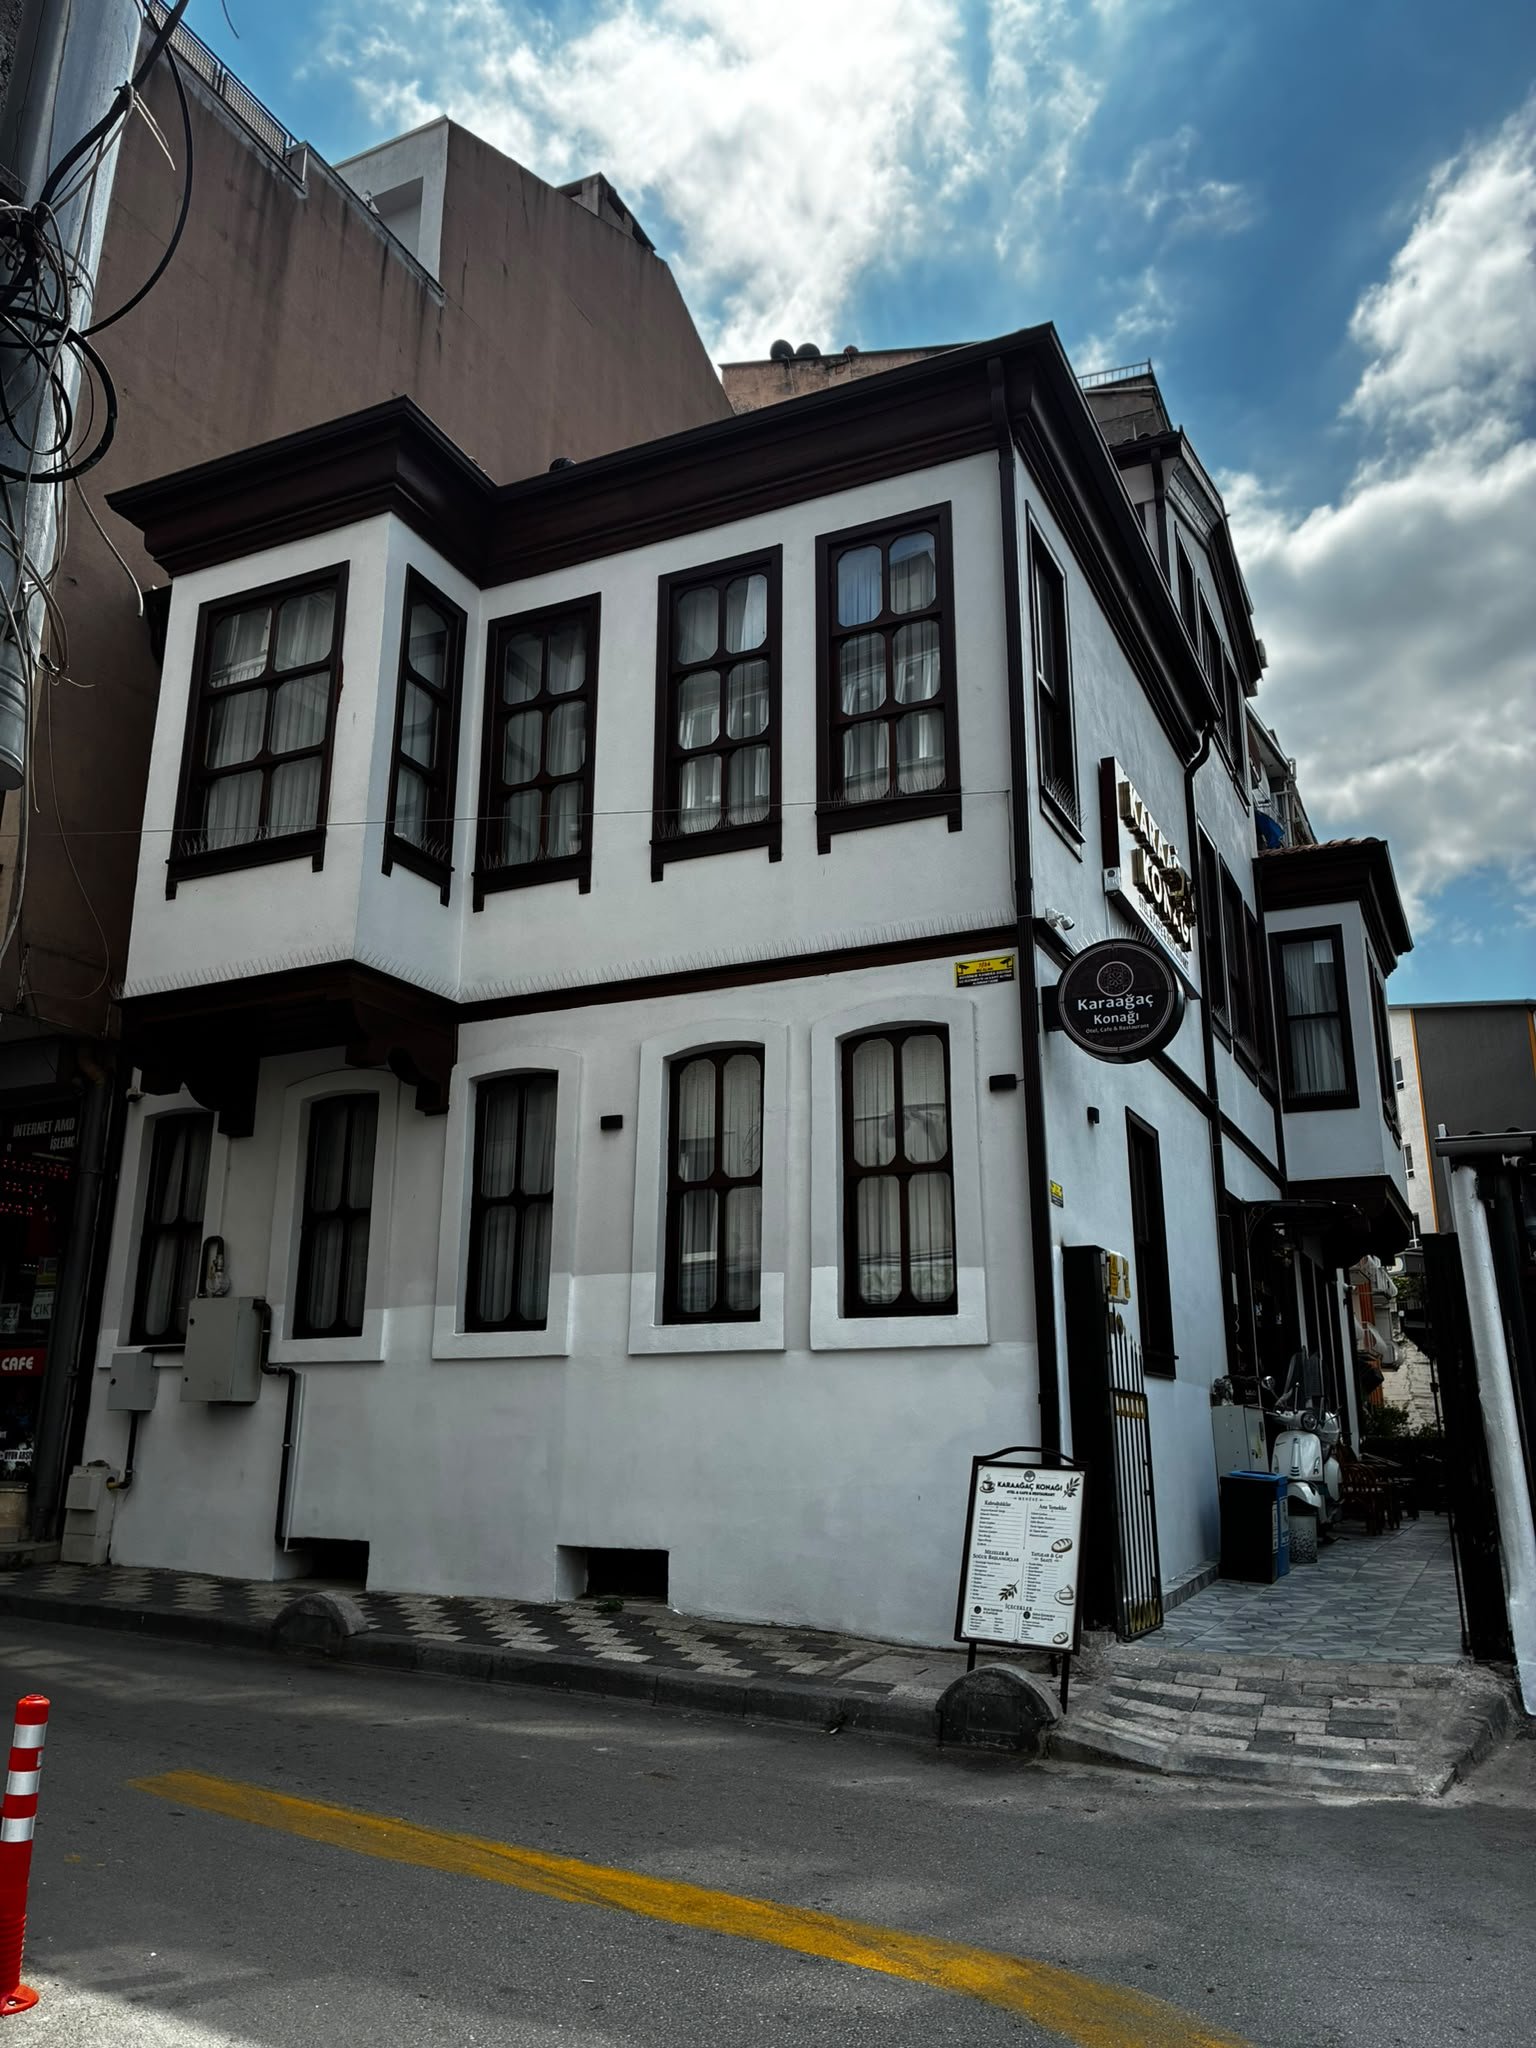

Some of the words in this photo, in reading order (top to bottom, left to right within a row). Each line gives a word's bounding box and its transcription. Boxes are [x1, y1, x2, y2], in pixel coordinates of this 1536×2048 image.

[1077, 994, 1154, 1011] Karaağaç
[1093, 1012, 1139, 1025] Konağı
[0, 1355, 35, 1371] CAFE
[997, 1481, 1034, 1491] KARAAĞAÇ
[1035, 1483, 1063, 1491] KONAĞI
